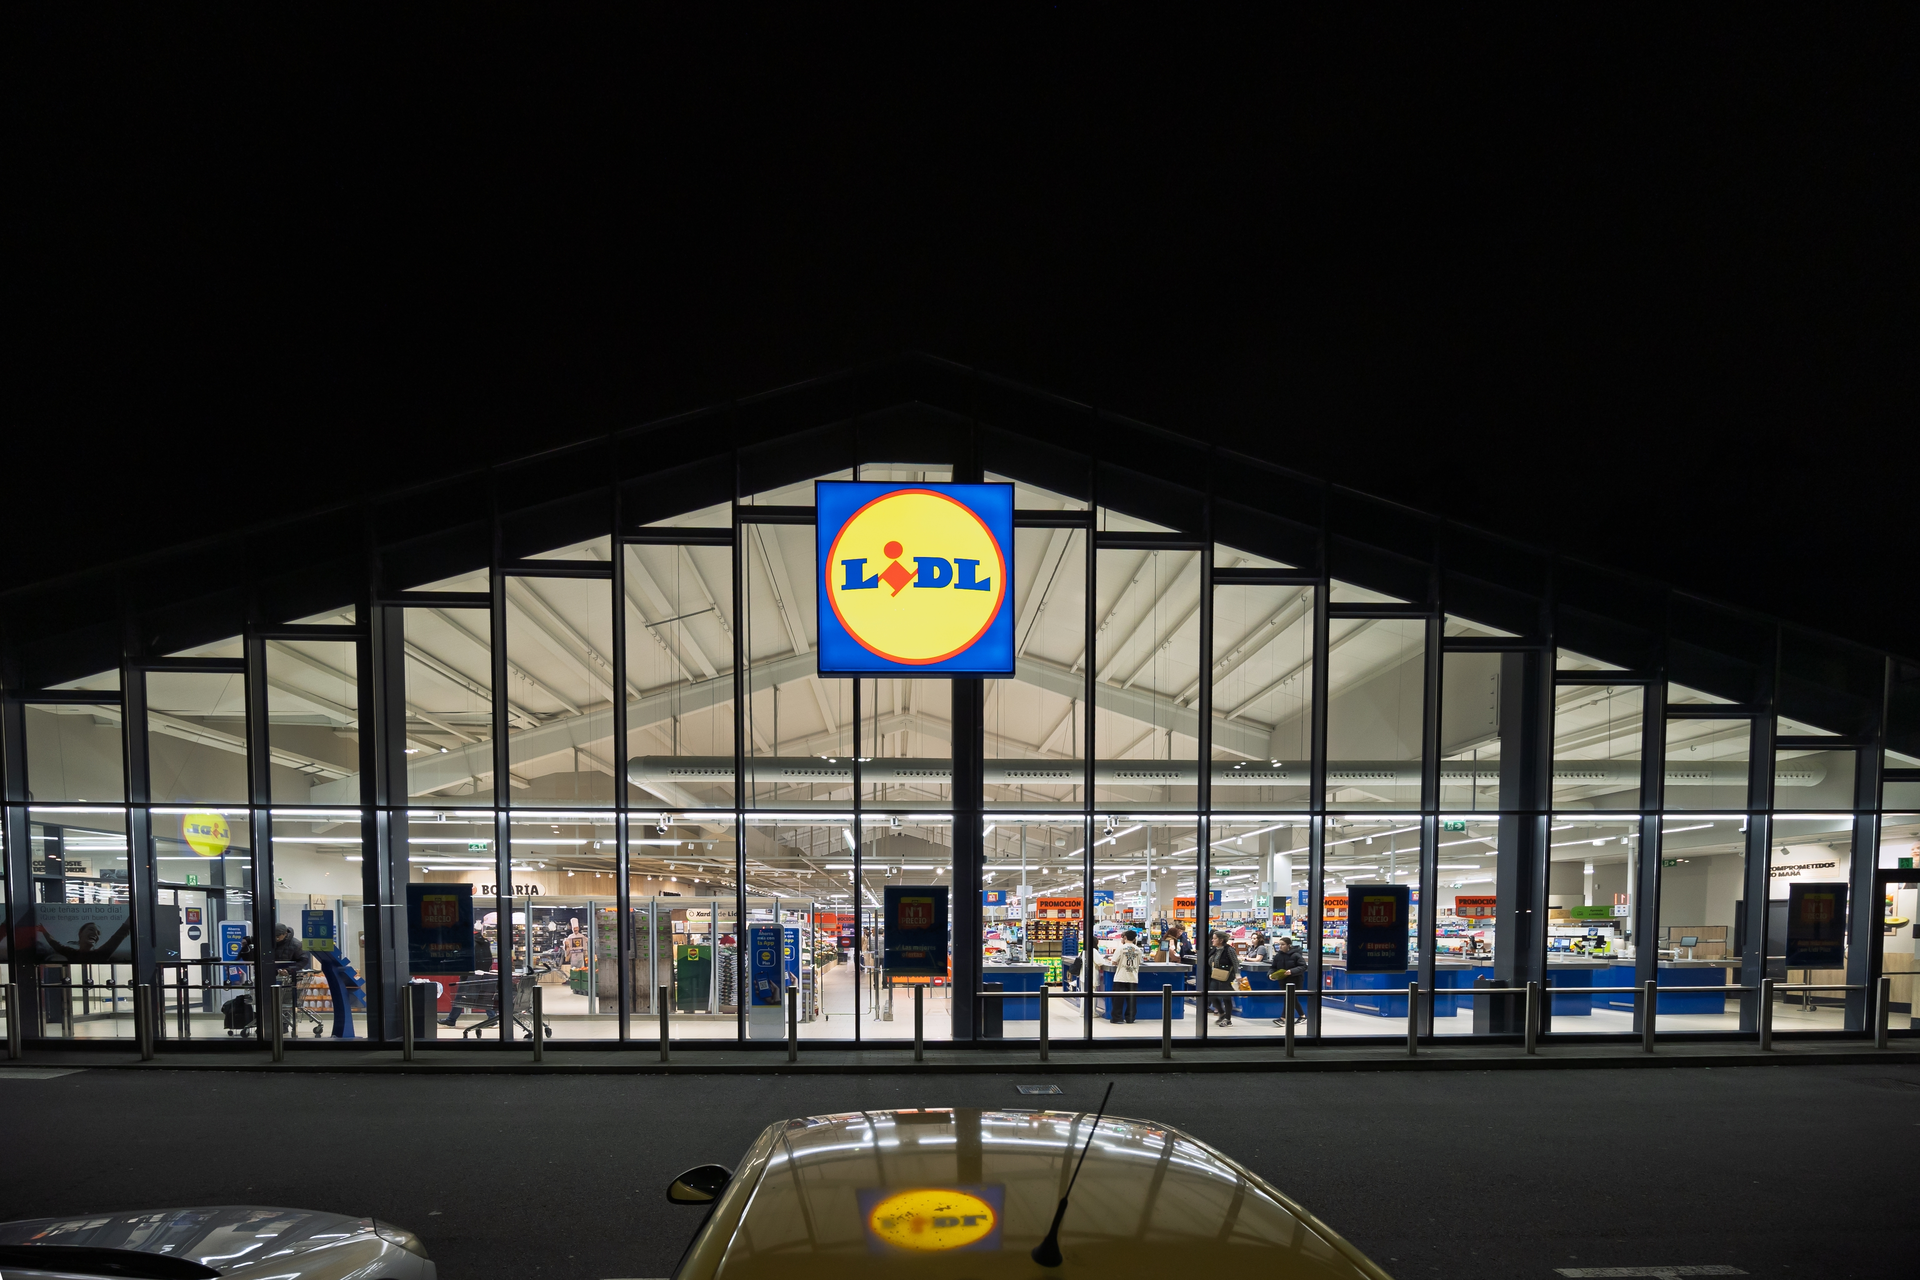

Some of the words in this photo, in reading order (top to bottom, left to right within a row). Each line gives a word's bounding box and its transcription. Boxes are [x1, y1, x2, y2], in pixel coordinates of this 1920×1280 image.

[40, 906, 56, 914] Que
[57, 914, 79, 922] tengas
[1374, 942, 1395, 950] precio
[1381, 950, 1395, 958] bajo
